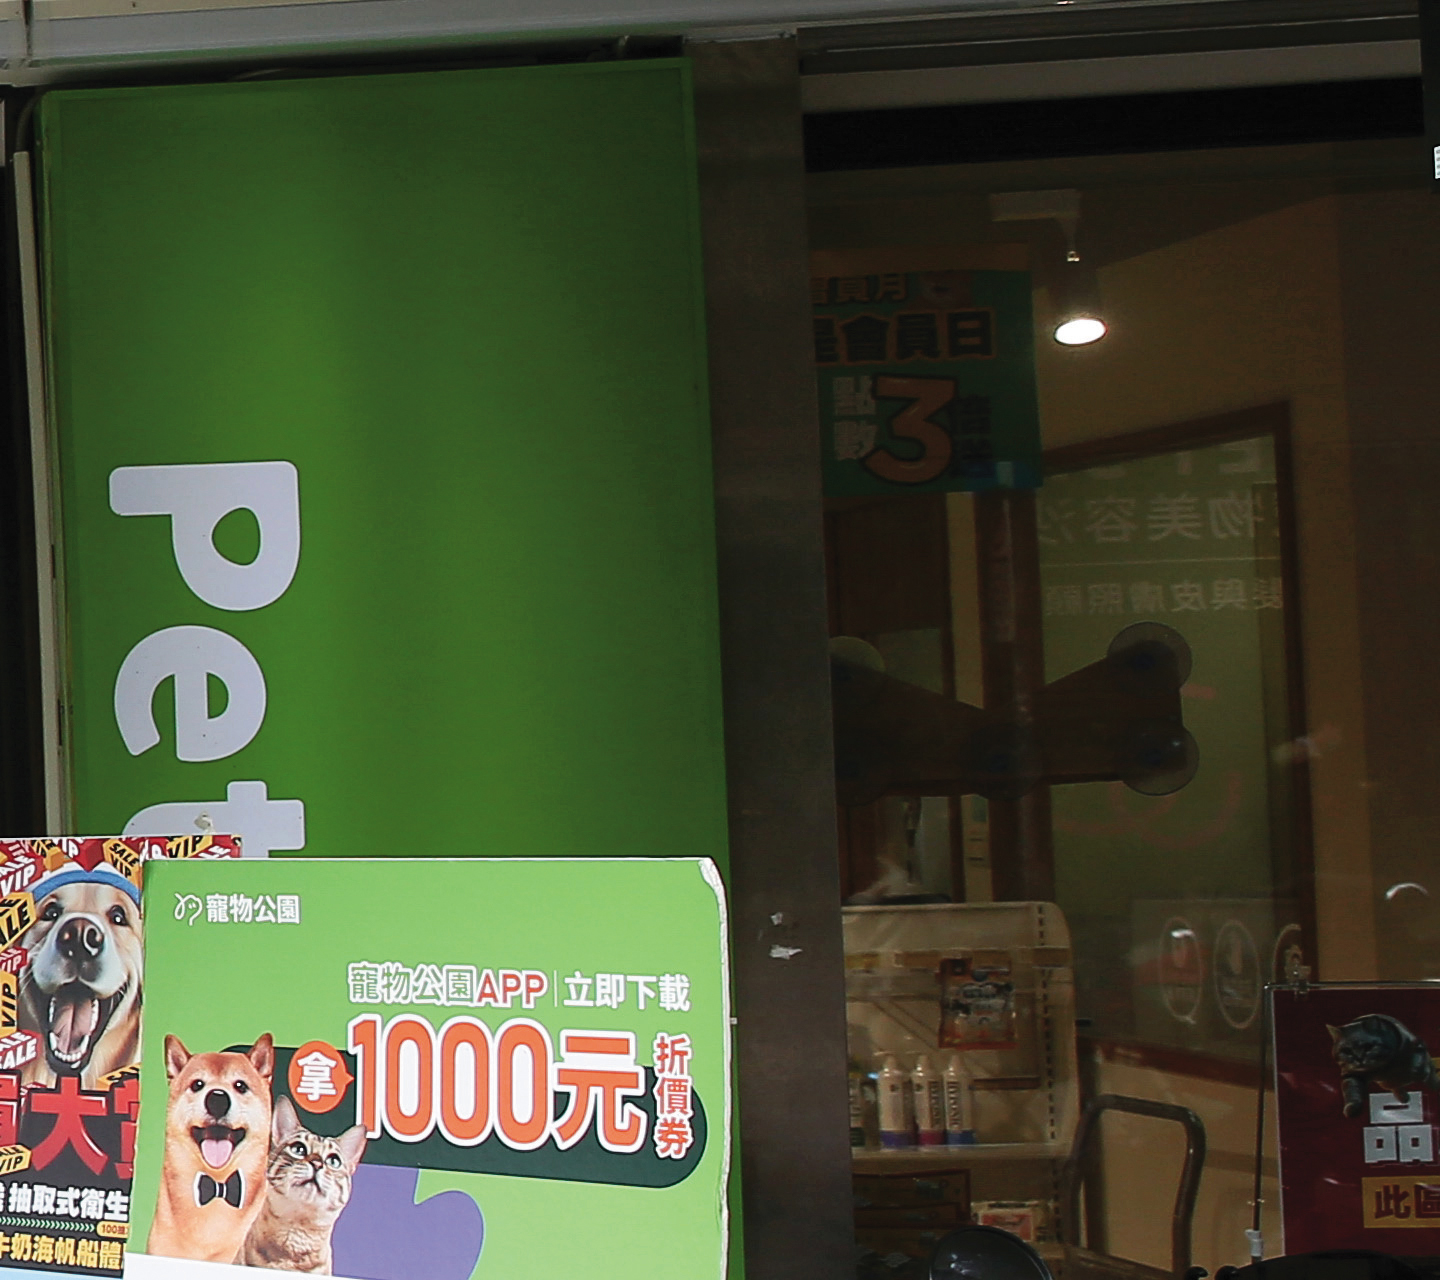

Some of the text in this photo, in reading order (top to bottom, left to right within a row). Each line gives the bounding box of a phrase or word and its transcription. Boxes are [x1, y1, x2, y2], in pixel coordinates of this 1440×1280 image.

[108, 460, 307, 858] Pet
[108, 842, 140, 868] SALE
[0, 863, 36, 897] VIP
[205, 893, 300, 924] 寵物公園
[347, 961, 691, 1013] 寵物公園APP 立即下載
[296, 1013, 693, 1159] 拿 1000元 折價券
[8, 1182, 130, 1221] 抽取式衛生
